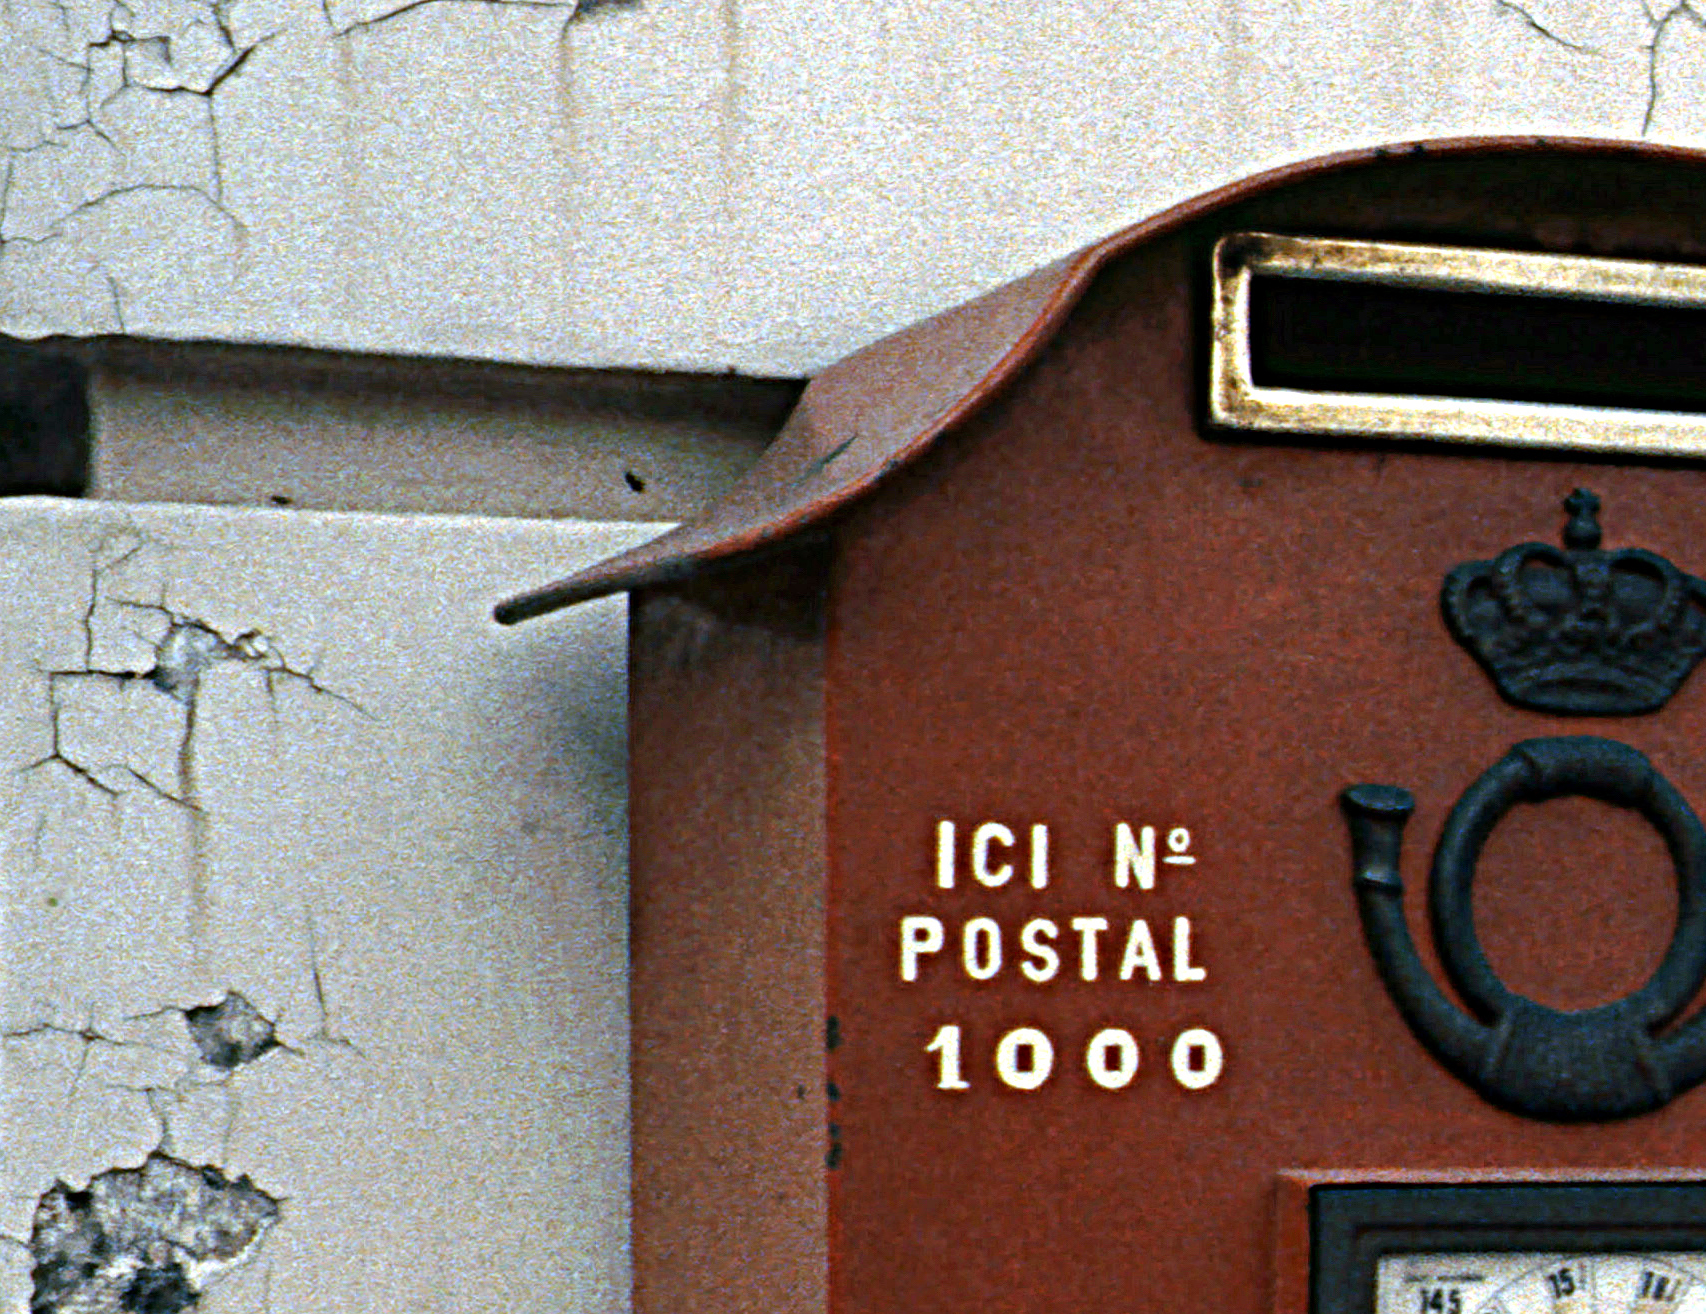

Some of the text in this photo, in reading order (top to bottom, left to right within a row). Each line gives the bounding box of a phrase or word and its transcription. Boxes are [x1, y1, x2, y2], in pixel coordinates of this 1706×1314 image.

[937, 820, 1048, 889] ICI
[901, 916, 1207, 982] POSTAL
[925, 1025, 1223, 1090] 1000
